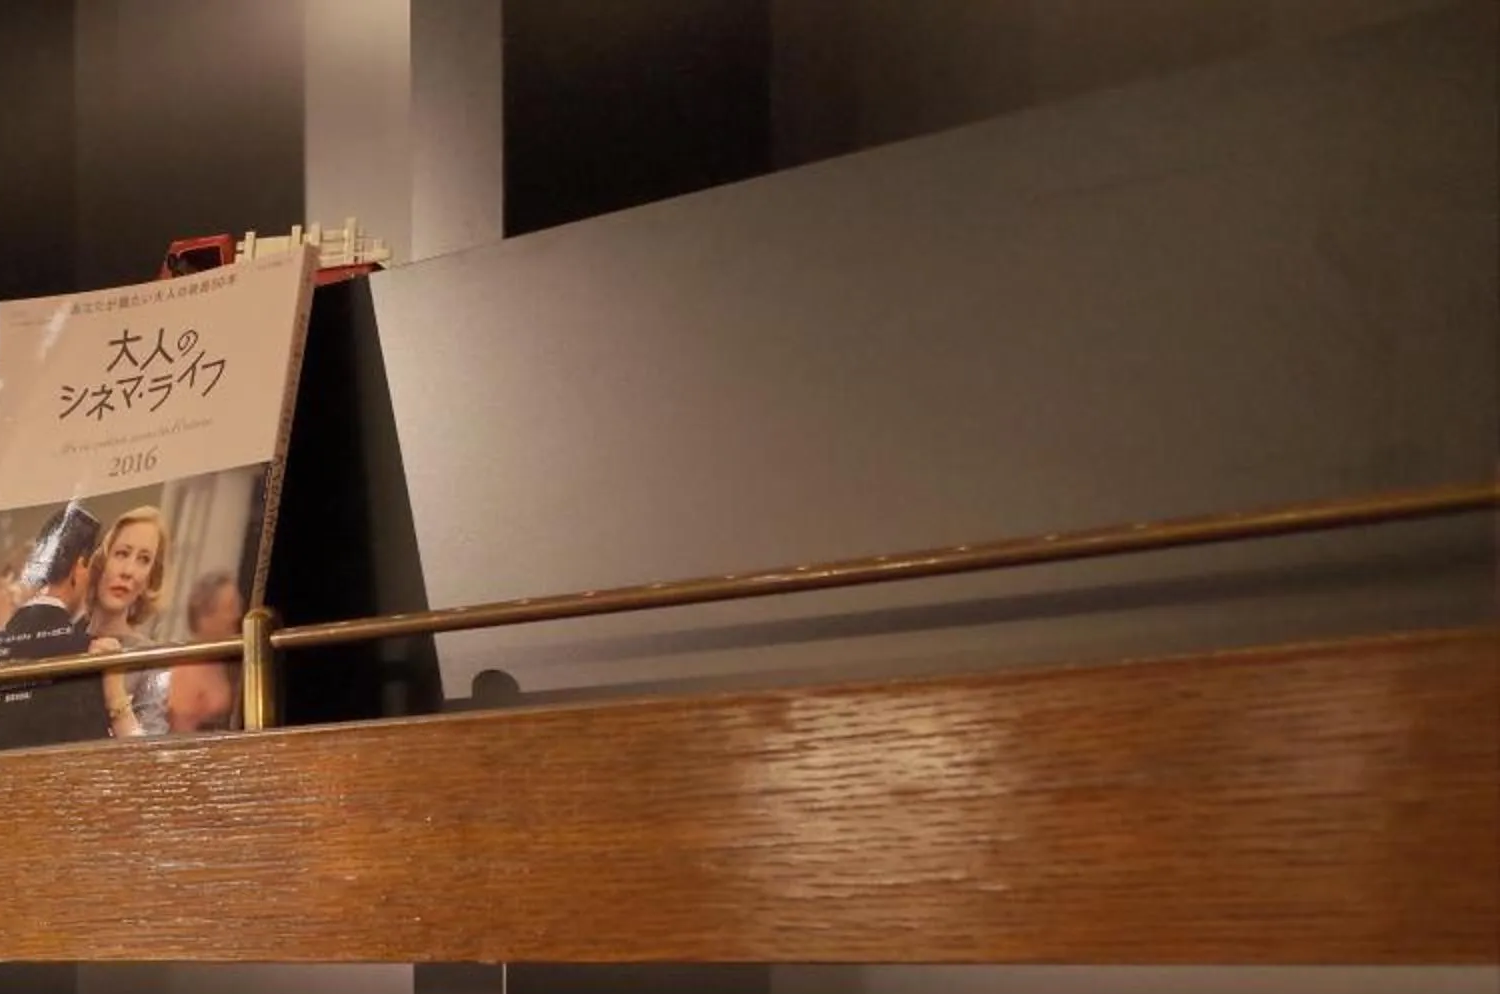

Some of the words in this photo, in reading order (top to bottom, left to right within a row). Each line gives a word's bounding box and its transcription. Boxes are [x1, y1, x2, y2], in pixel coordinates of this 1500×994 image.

[106, 327, 199, 372] 大人の
[59, 350, 227, 421] シネマ・ライフ
[108, 446, 159, 478] 2016
